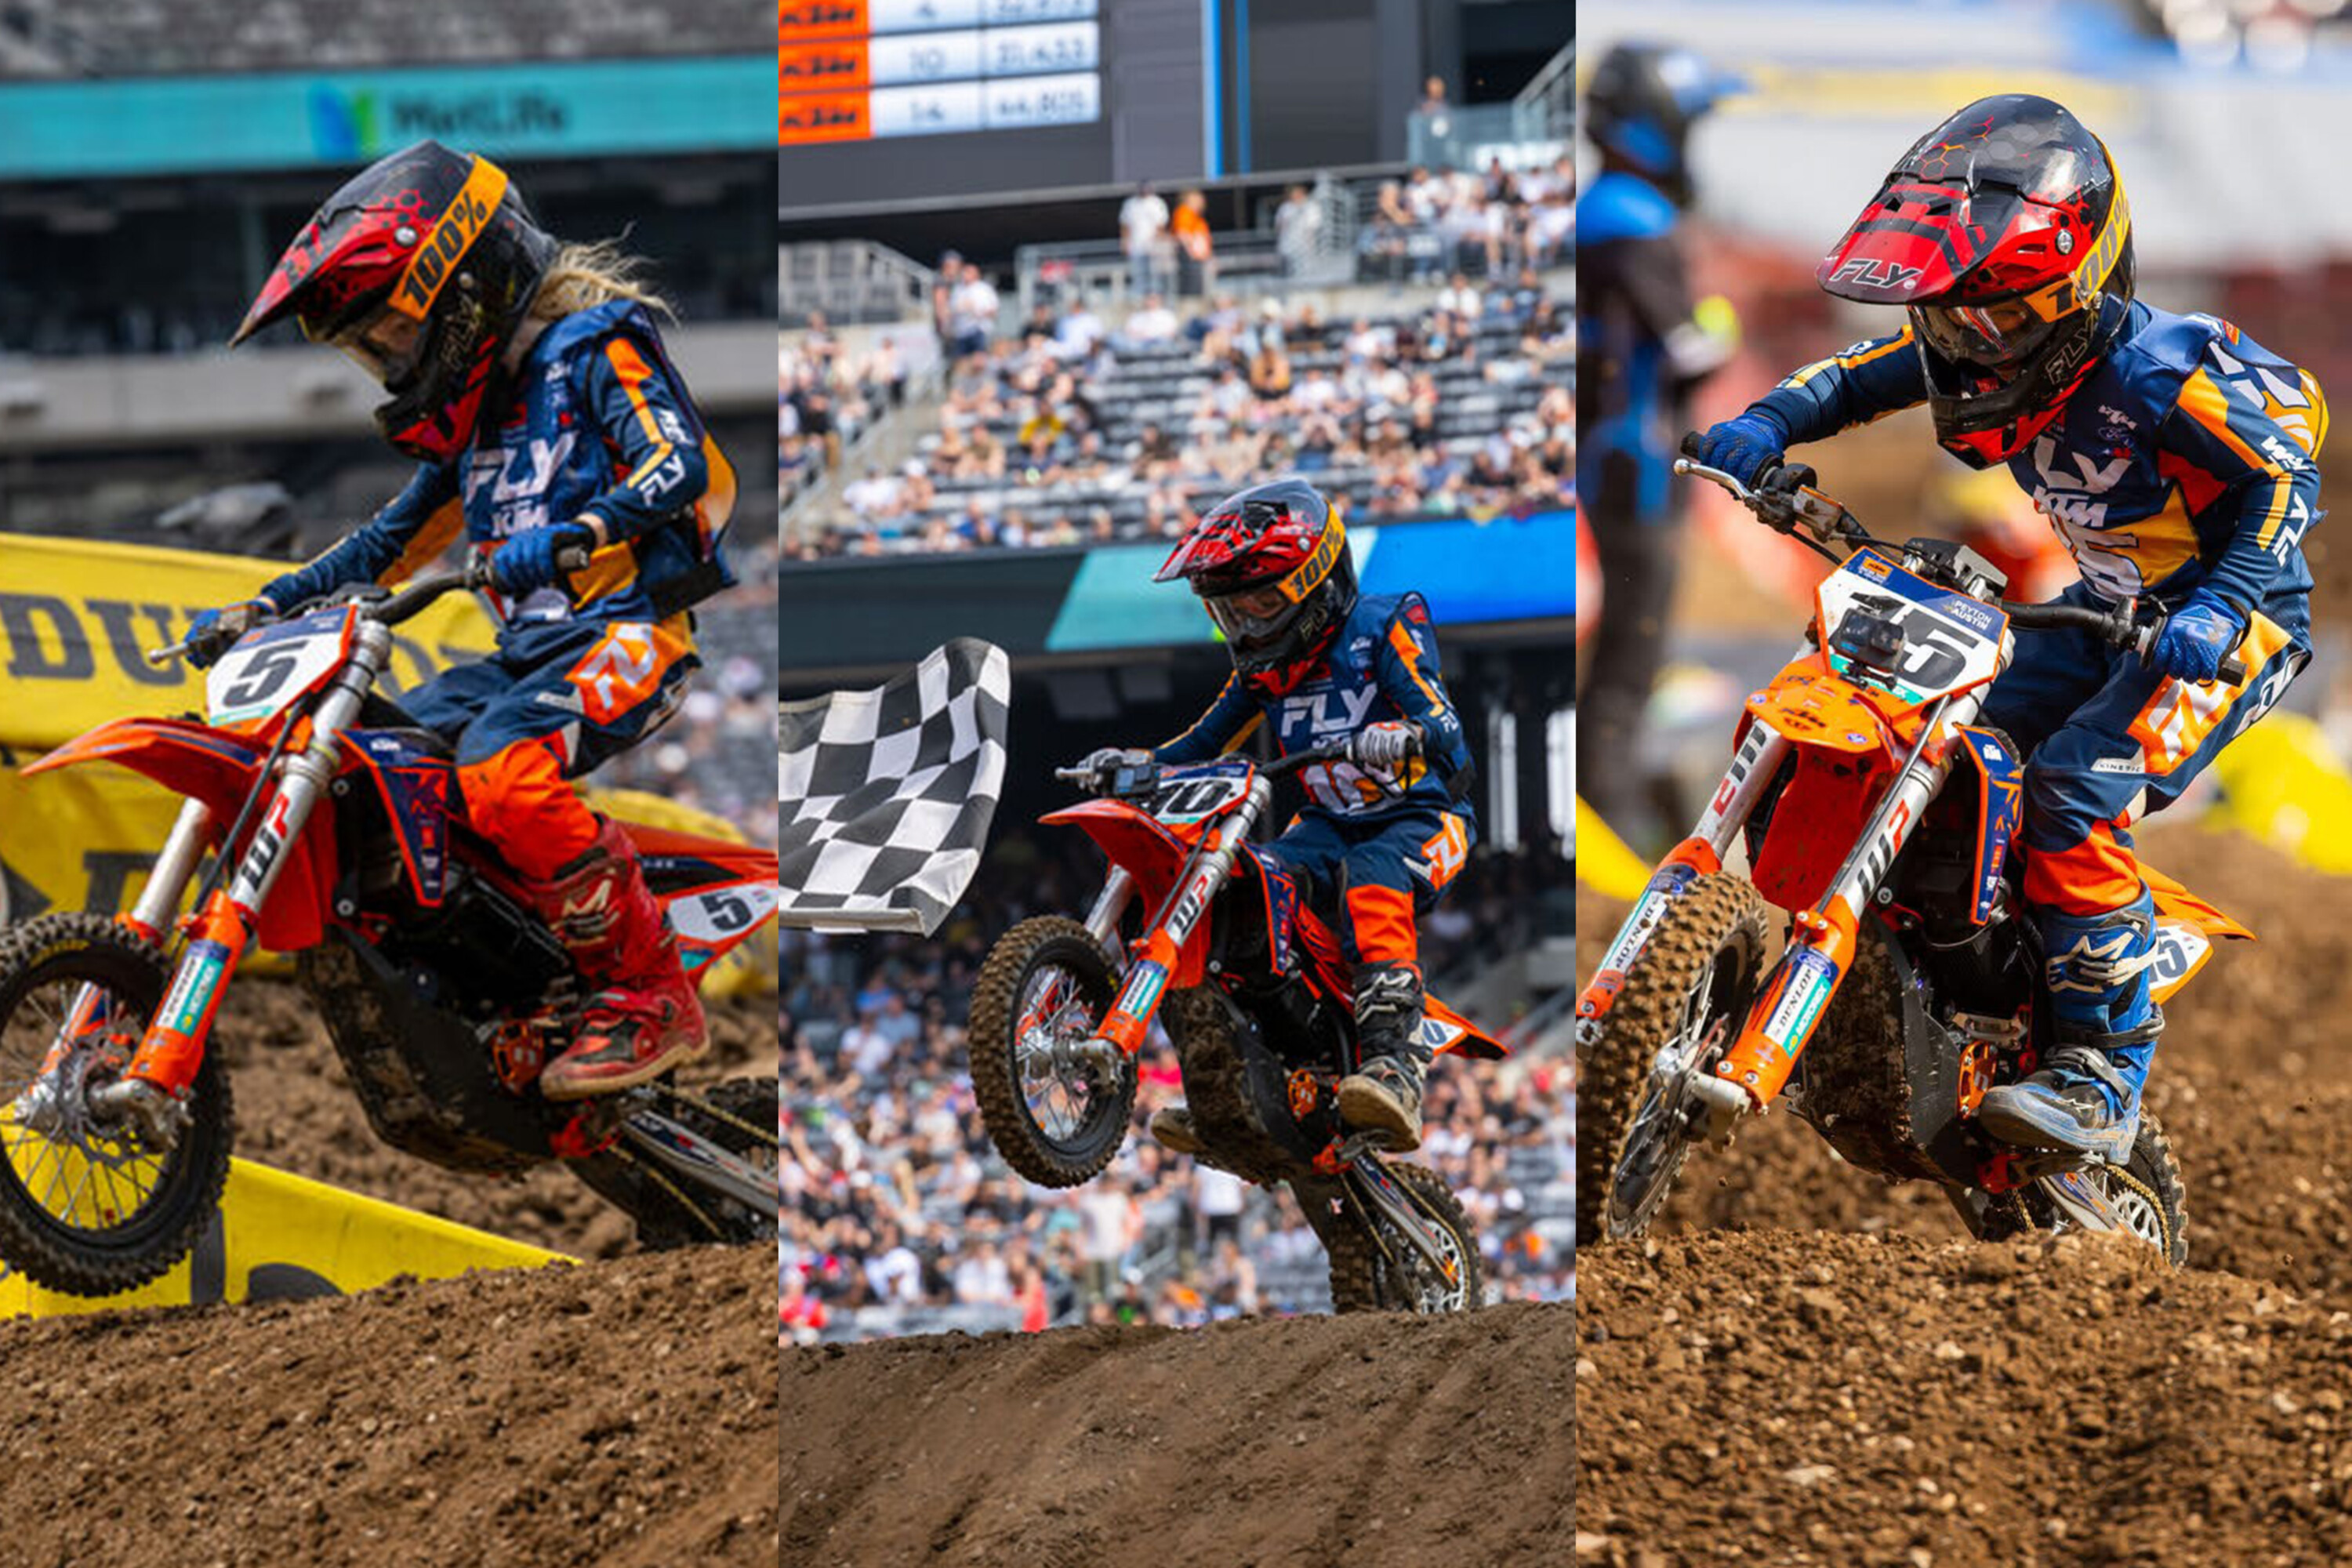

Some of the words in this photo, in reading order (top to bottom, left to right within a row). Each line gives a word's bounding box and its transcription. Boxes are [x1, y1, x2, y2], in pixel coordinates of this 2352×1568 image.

[401, 191, 488, 305] 100%
[1829, 258, 1922, 289] FLY
[2045, 318, 2098, 386] FLY
[465, 430, 580, 505] FLY
[638, 453, 686, 507] FLY
[2272, 491, 2310, 568] FLY
[1288, 528, 1342, 597] 100%
[1951, 608, 1989, 631] AUSTIN
[1953, 600, 1992, 626] PEYTON
[223, 640, 309, 707] 5
[1280, 681, 1378, 737] FLY
[699, 890, 753, 932] 5
[1615, 907, 1654, 969] DNLOP
[1779, 968, 1812, 1028] DUNLOP
